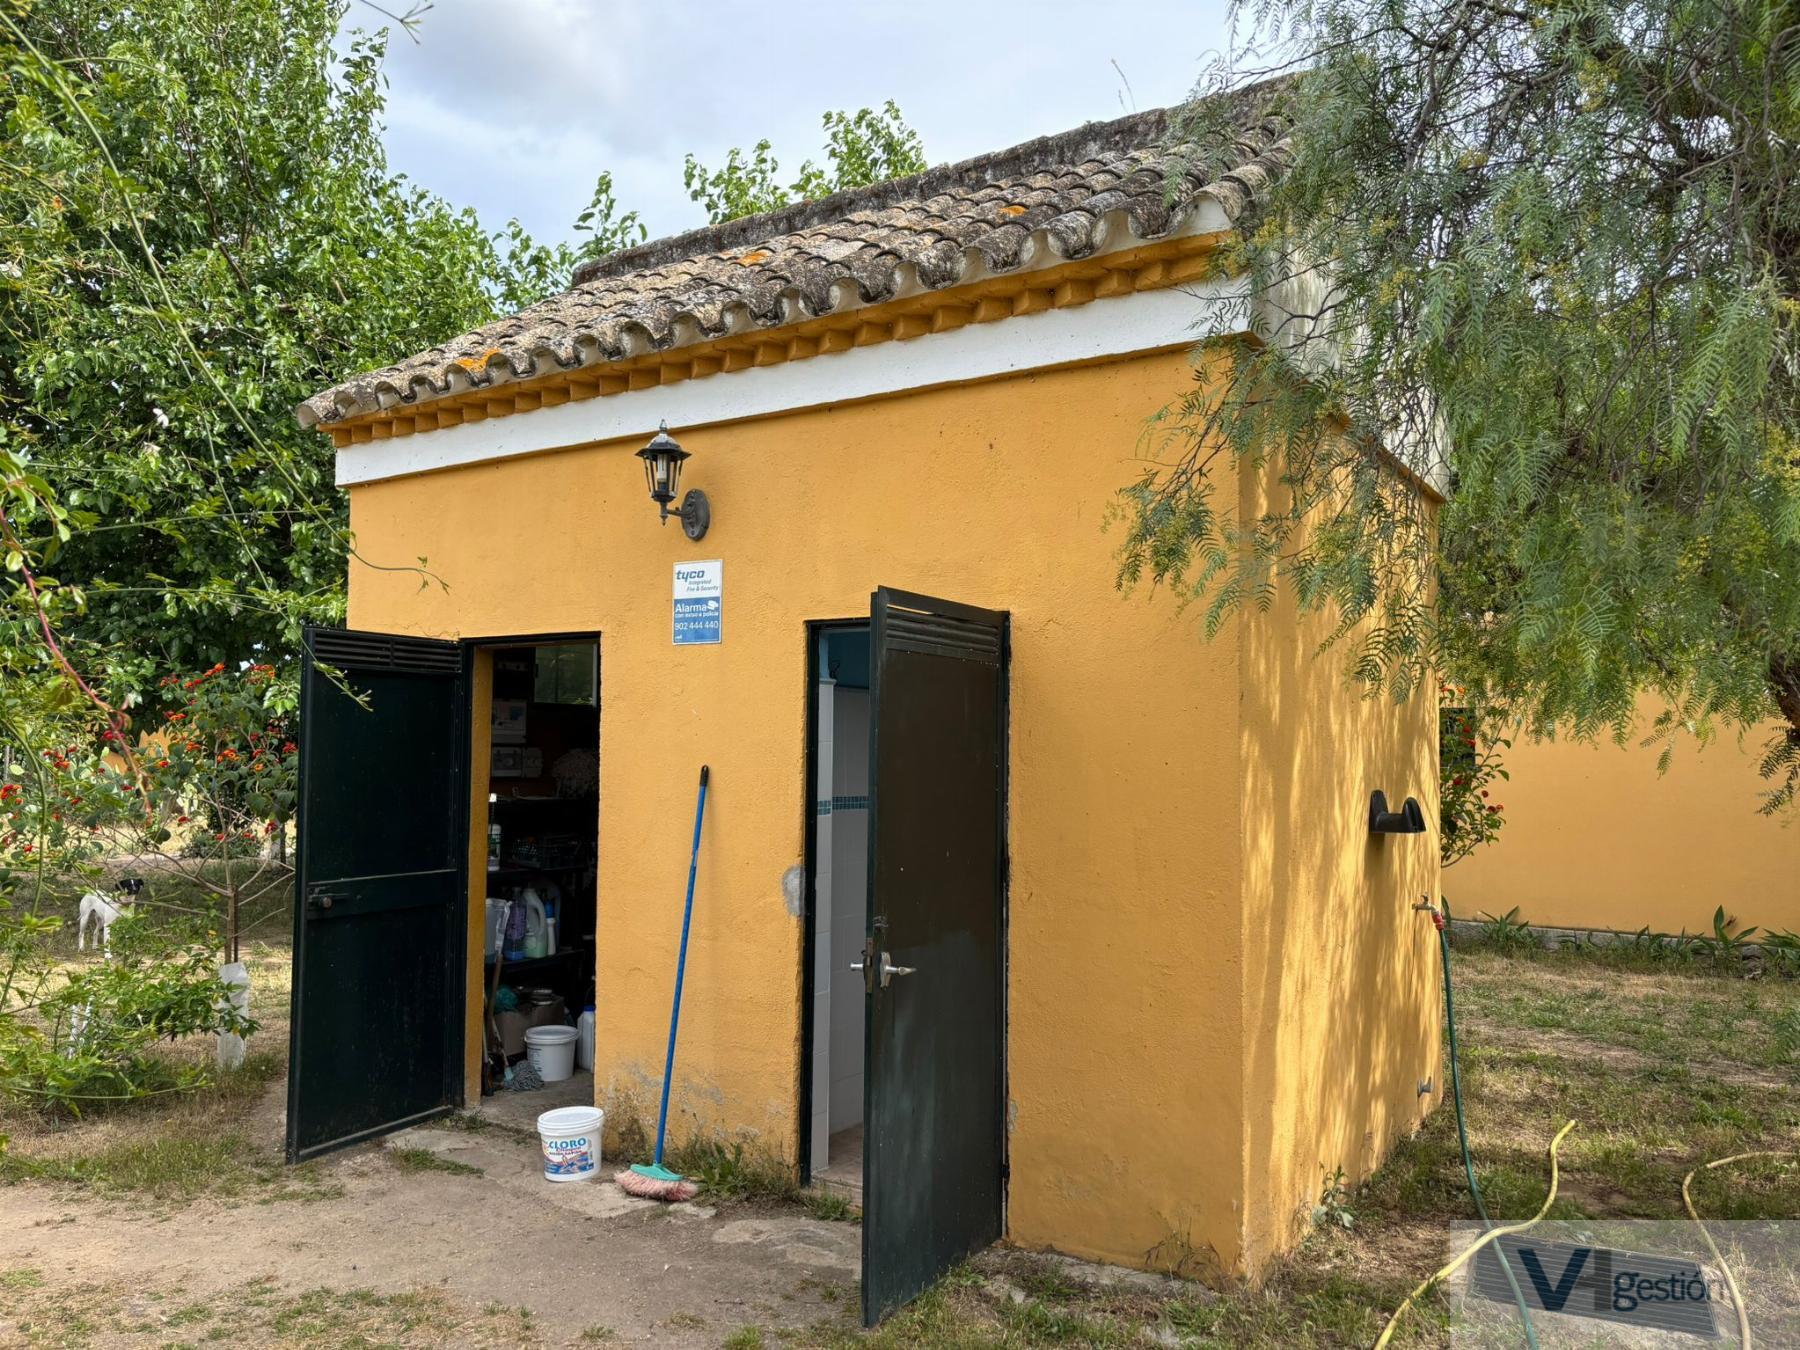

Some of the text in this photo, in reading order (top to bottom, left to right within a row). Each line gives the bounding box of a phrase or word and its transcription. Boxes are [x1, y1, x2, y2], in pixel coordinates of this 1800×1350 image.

[676, 570, 705, 582] tyco
[676, 604, 707, 612] Alarma
[675, 622, 688, 630] 902
[704, 621, 719, 629] 440
[549, 1137, 586, 1149] CLORO
